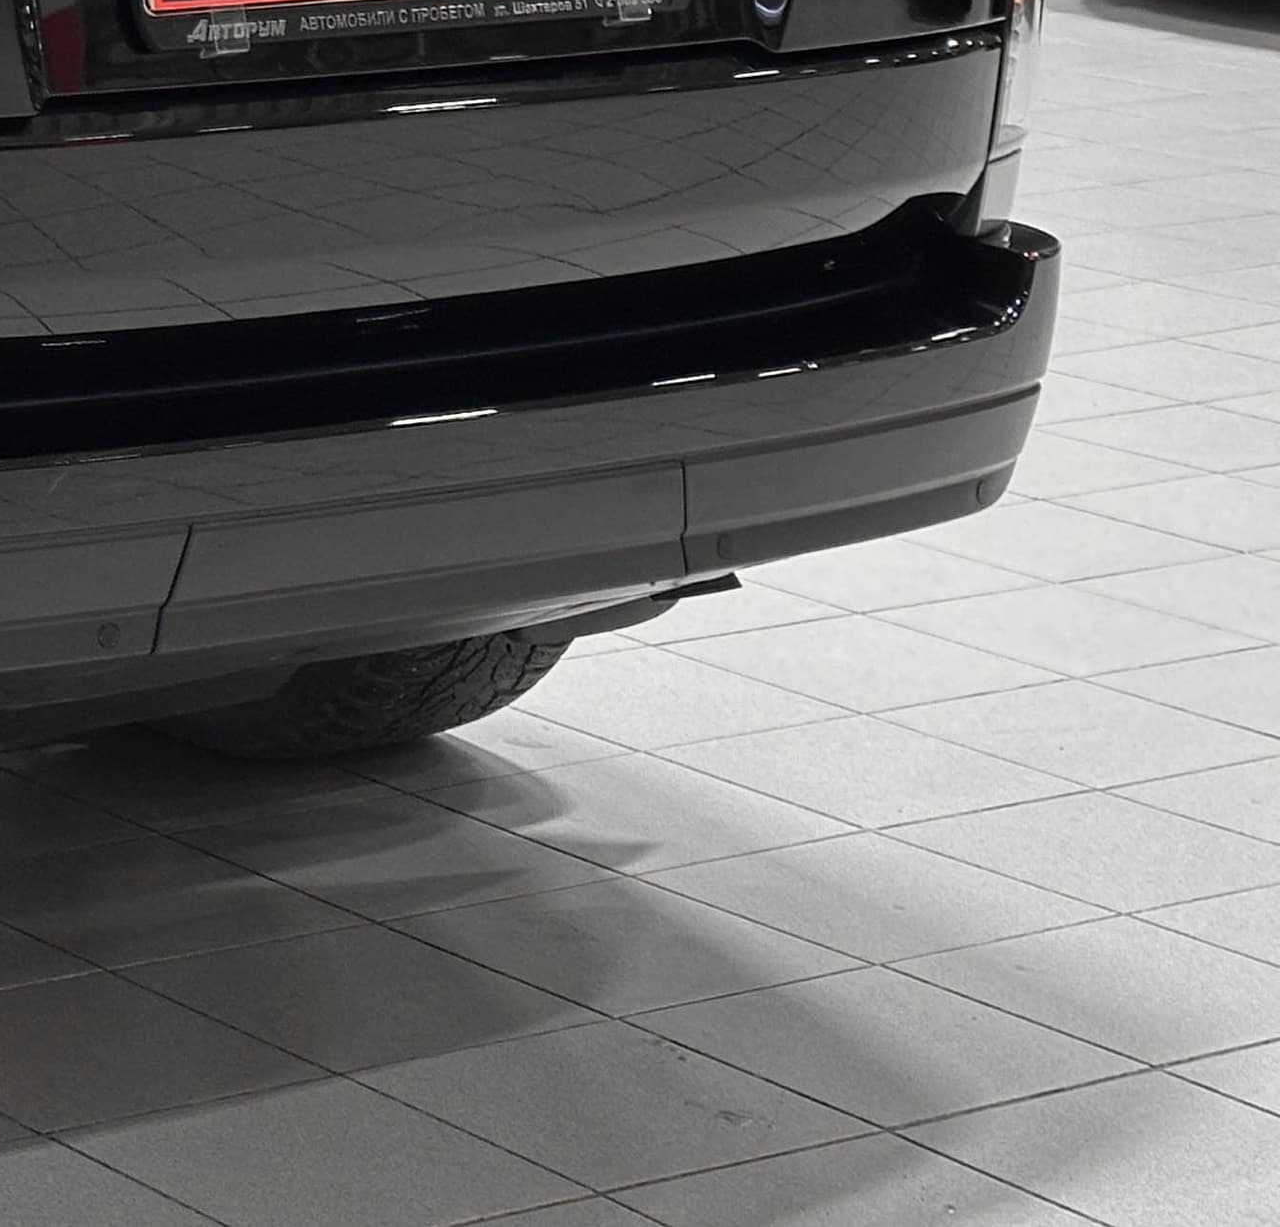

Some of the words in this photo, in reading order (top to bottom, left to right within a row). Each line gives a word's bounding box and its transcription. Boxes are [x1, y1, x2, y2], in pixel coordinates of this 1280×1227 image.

[299, 9, 396, 32] АВТОМОБИЛИ
[399, 8, 409, 24] С
[410, 2, 486, 25] ПРОБЕГОМ
